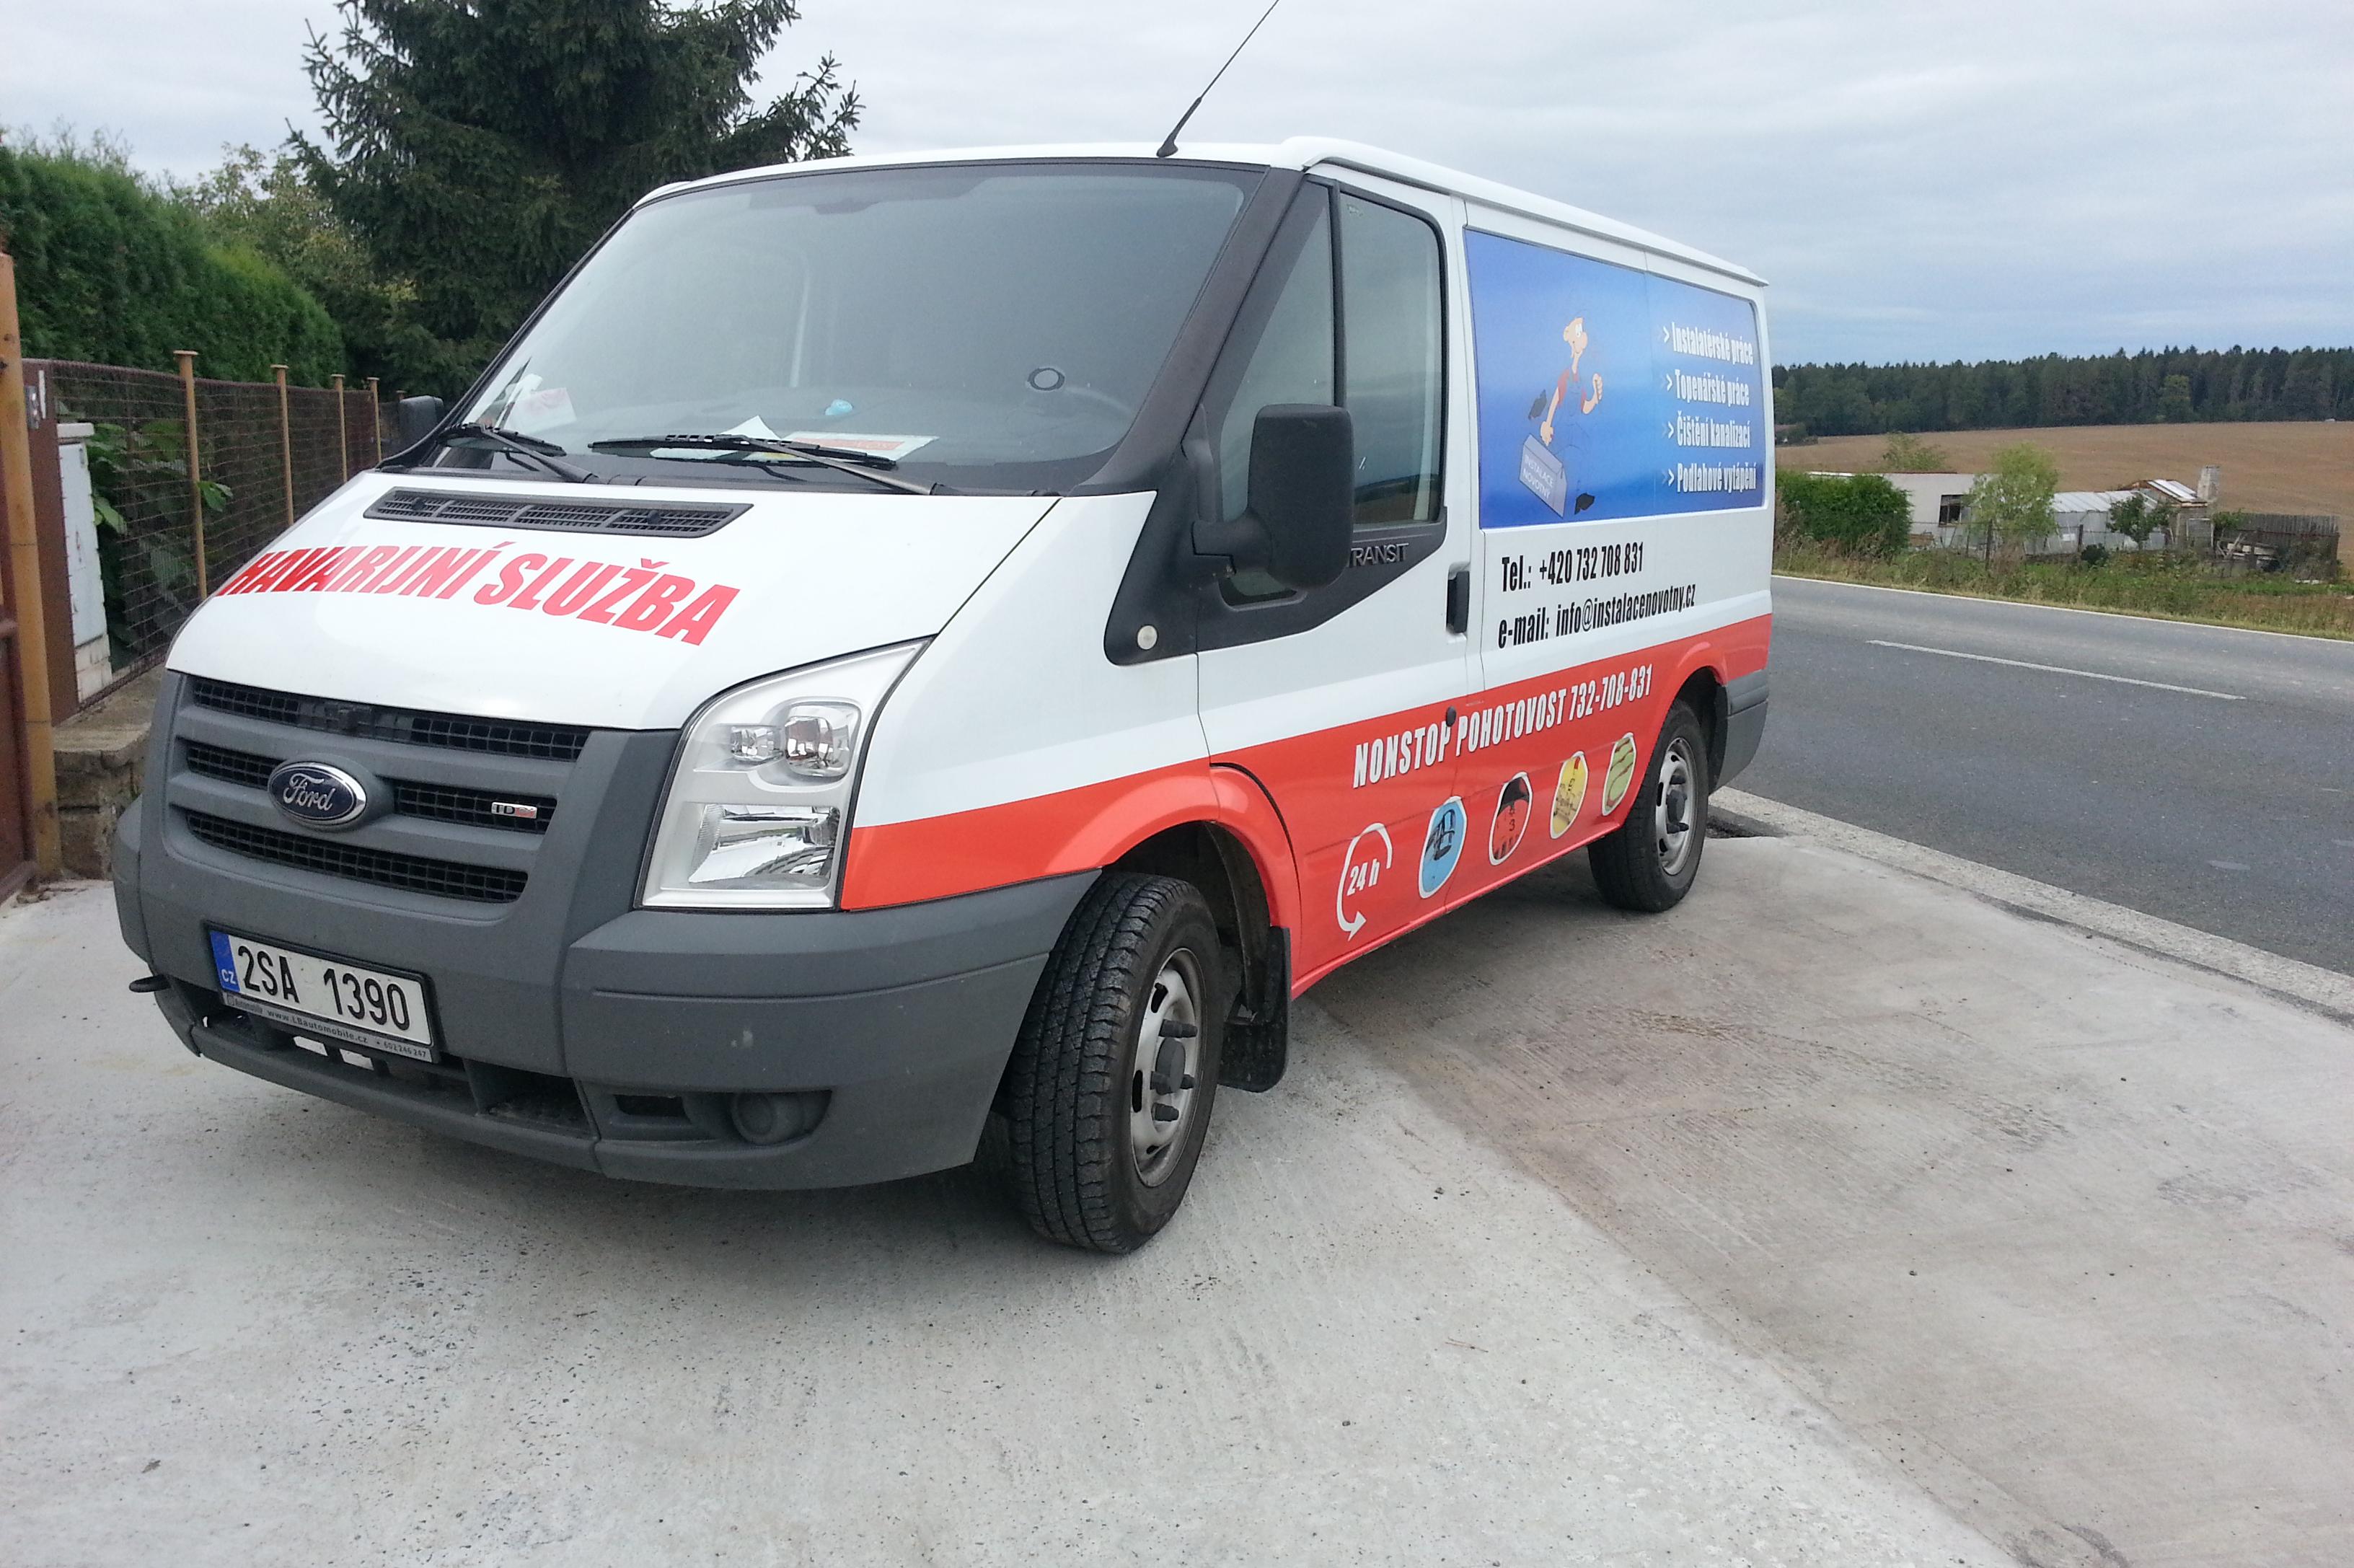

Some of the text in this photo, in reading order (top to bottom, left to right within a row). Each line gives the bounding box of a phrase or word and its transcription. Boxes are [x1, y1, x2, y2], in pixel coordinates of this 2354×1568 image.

[1731, 336, 1753, 365] práce
[1675, 369, 1749, 407] Topenářské práce
[1677, 410, 1750, 448] Čištění kanalizací
[1677, 462, 1756, 493] Podlahové vytápění
[1502, 542, 1644, 592] Tel.: +420 732 708 831
[218, 542, 741, 646] HAVARIJNÍ SLUŽBA
[1498, 583, 1696, 649] e-mail: info@instalacenovotny.cz
[1353, 663, 1653, 788] NONSTOP POHOTOVOST 732-708-831
[283, 772, 336, 811] Ford
[1346, 858, 1380, 896] 24 h
[221, 969, 237, 985] CZ
[238, 946, 410, 1031] 2SA 1390
